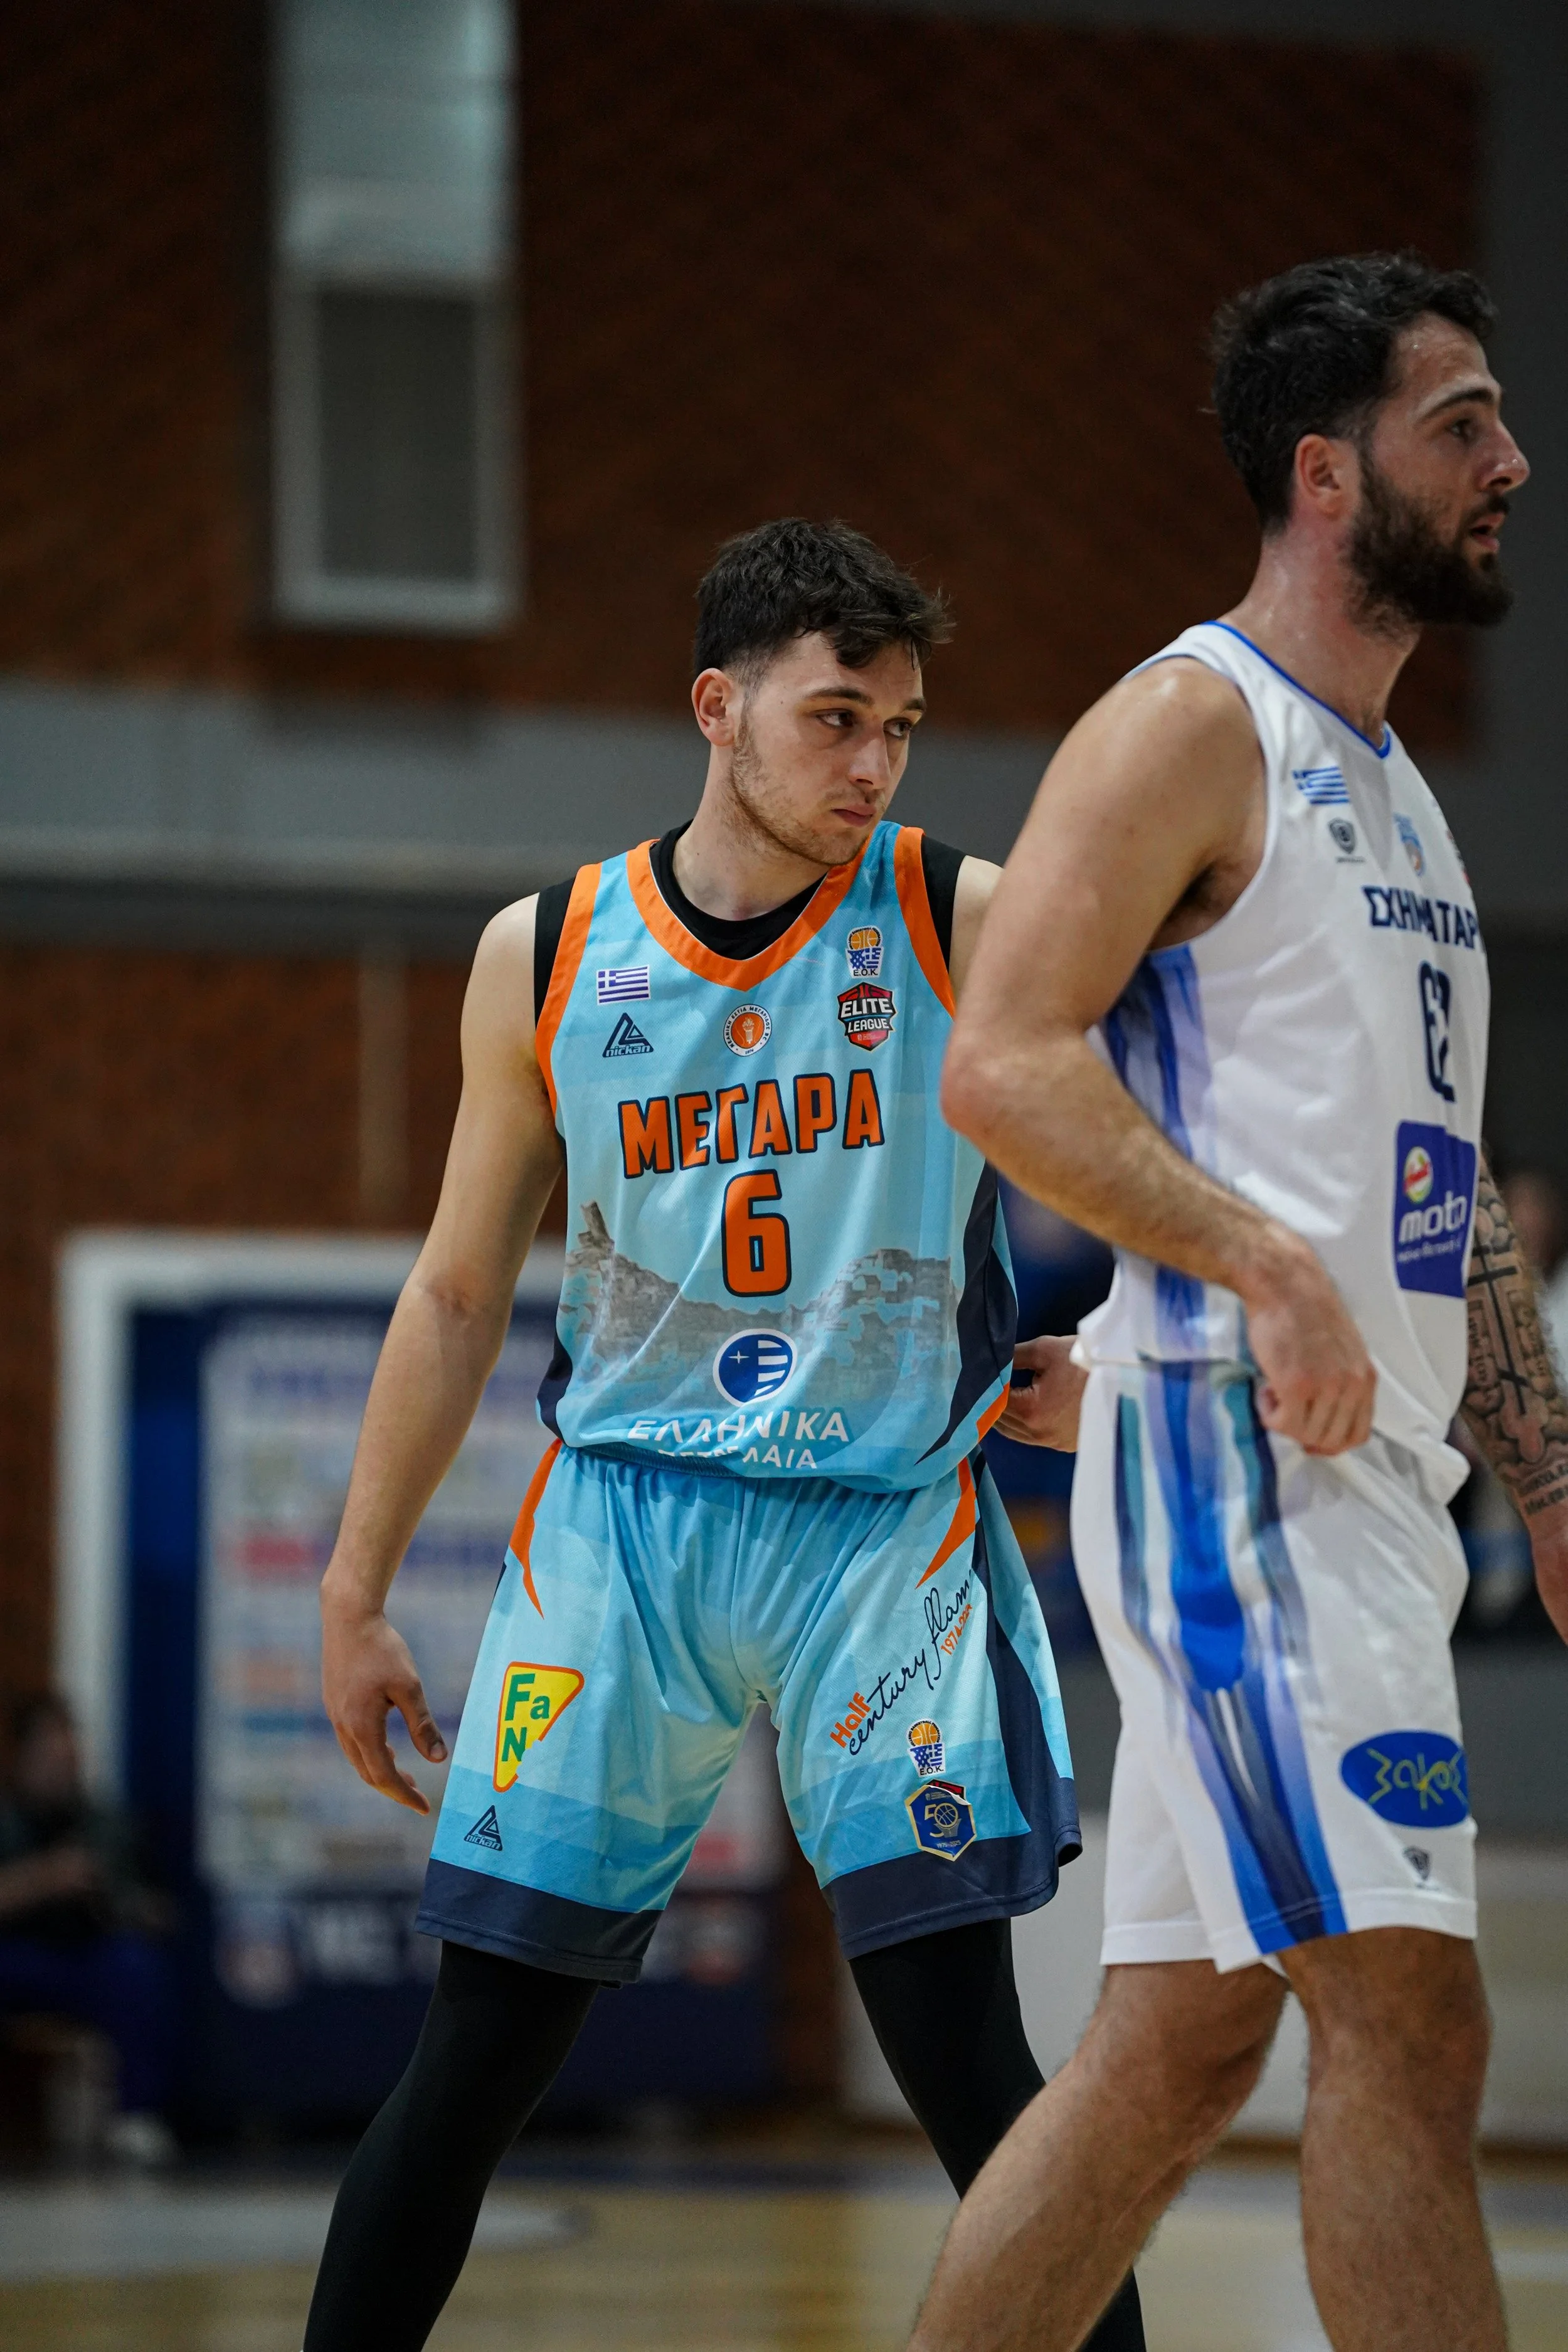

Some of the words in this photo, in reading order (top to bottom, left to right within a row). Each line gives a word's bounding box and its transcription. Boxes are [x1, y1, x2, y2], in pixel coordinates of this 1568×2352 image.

[840, 998, 893, 1018] ELITE
[847, 1018, 890, 1034] LEAGUE
[605, 1045, 650, 1057] nickan
[618, 1068, 885, 1179] ΜΕΓΑΡΑ
[721, 1168, 792, 1298] 6
[829, 1691, 872, 1749] Half
[849, 1648, 935, 1756] century
[466, 1834, 501, 1850] nickan
